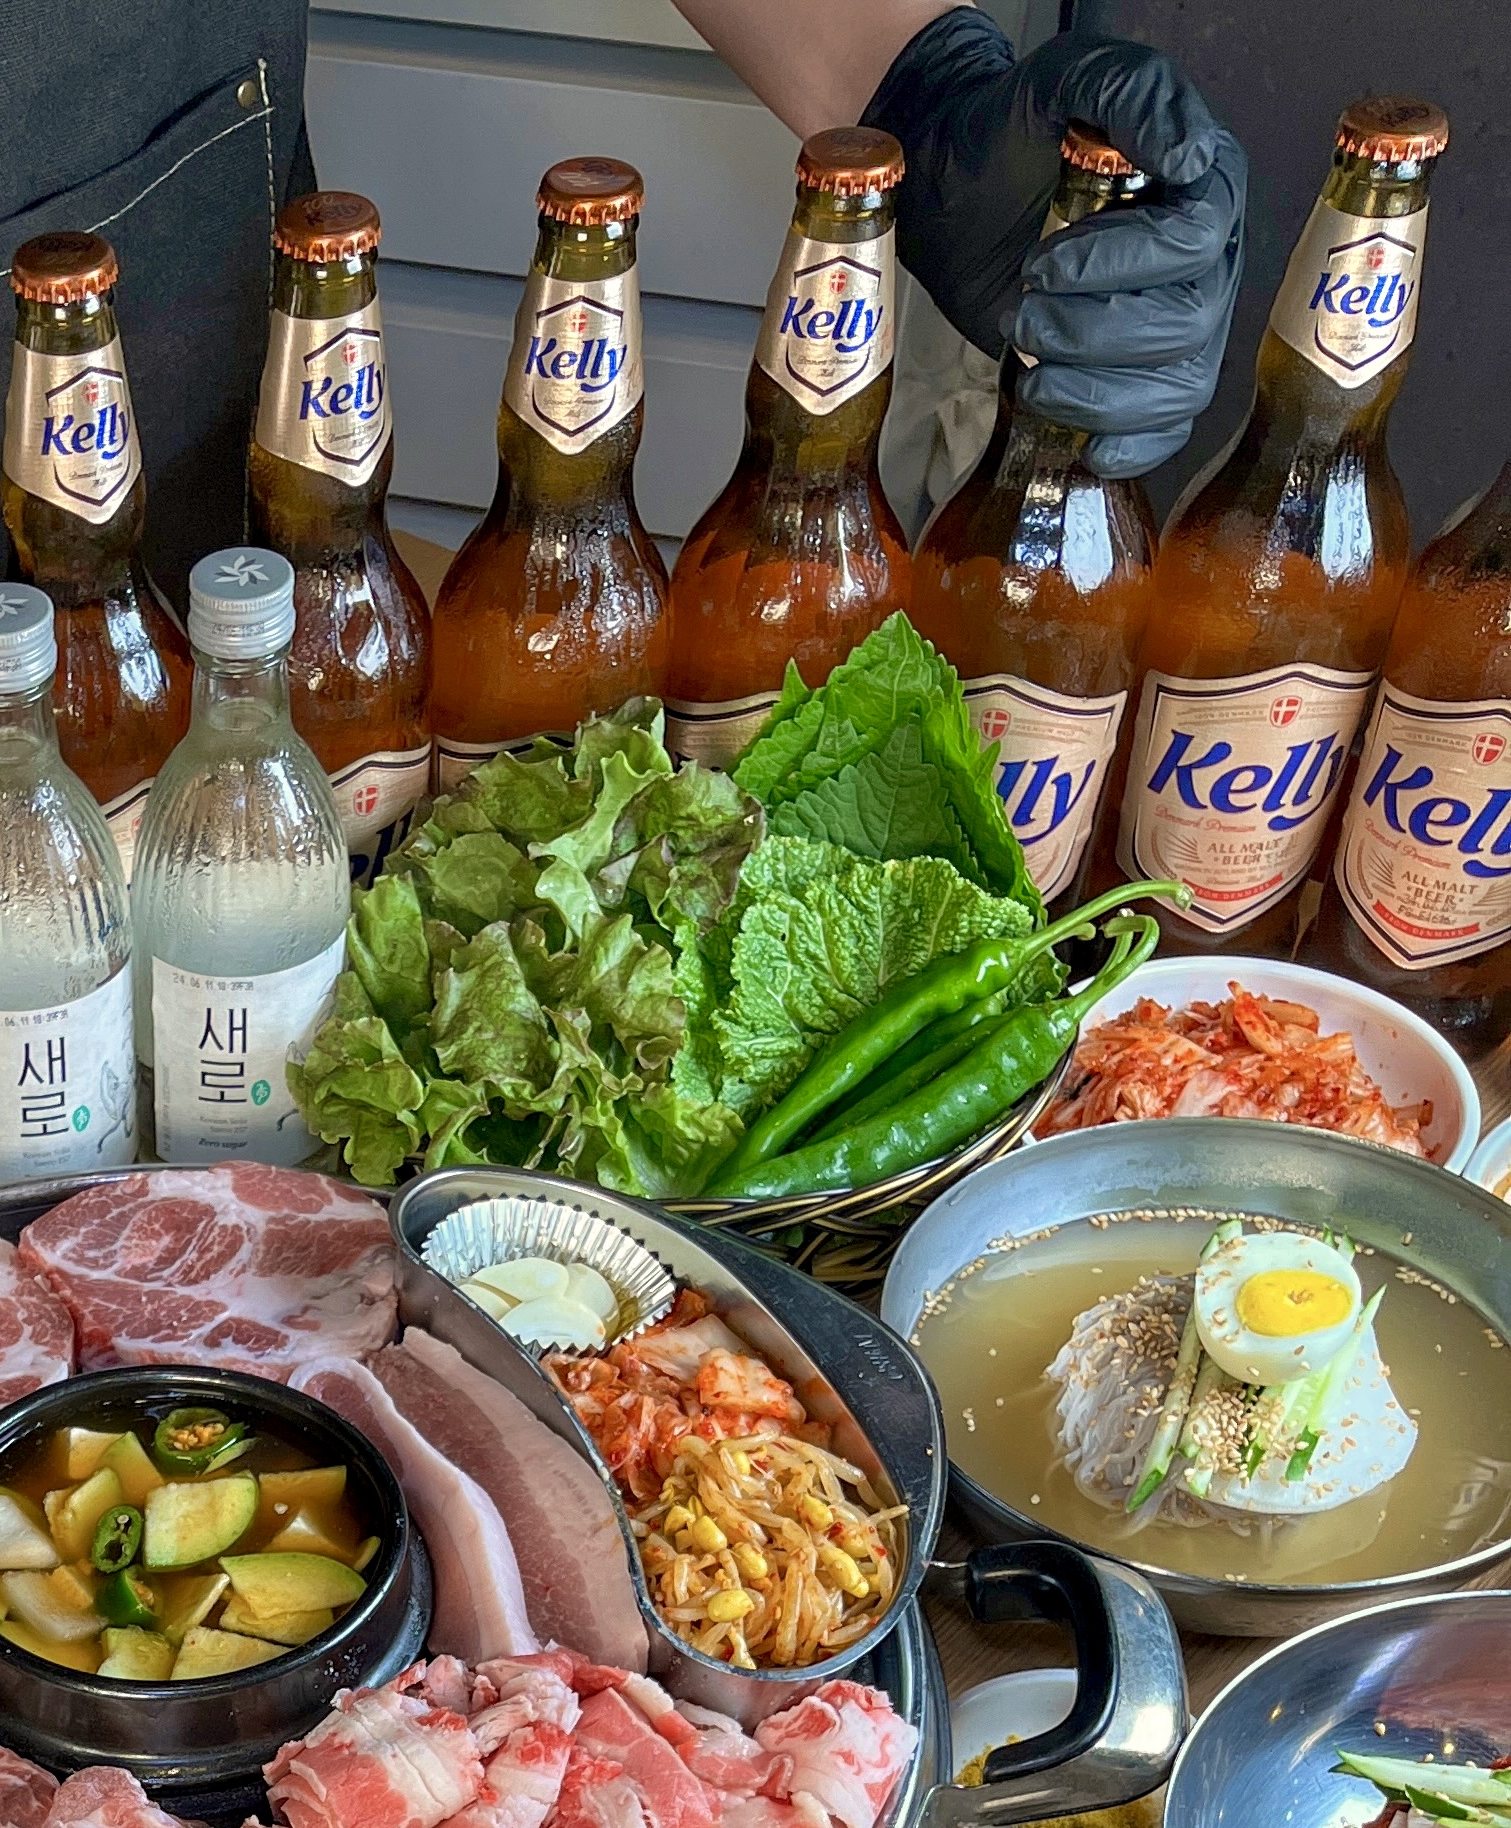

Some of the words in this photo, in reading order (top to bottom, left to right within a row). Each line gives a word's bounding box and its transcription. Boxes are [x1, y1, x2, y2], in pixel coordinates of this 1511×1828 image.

[780, 296, 883, 353] Kelly
[1309, 272, 1415, 328] Kelly
[299, 361, 385, 420] Kelly
[525, 336, 628, 393] Kelly
[41, 402, 130, 460] Kelly
[997, 754, 1096, 847] lly
[1147, 729, 1345, 832] Kelly
[1363, 743, 1511, 878] Kel
[1207, 842, 1235, 854] ALL
[1240, 837, 1284, 854] MALT
[1222, 853, 1262, 866] BEER
[1401, 871, 1430, 888] ALL
[1433, 879, 1479, 896] MALT
[1413, 887, 1456, 906] BEER
[198, 1008, 247, 1103] 새로
[18, 1036, 69, 1138] 새로
[199, 1137, 220, 1147] Zero
[221, 1139, 248, 1150] sugar
